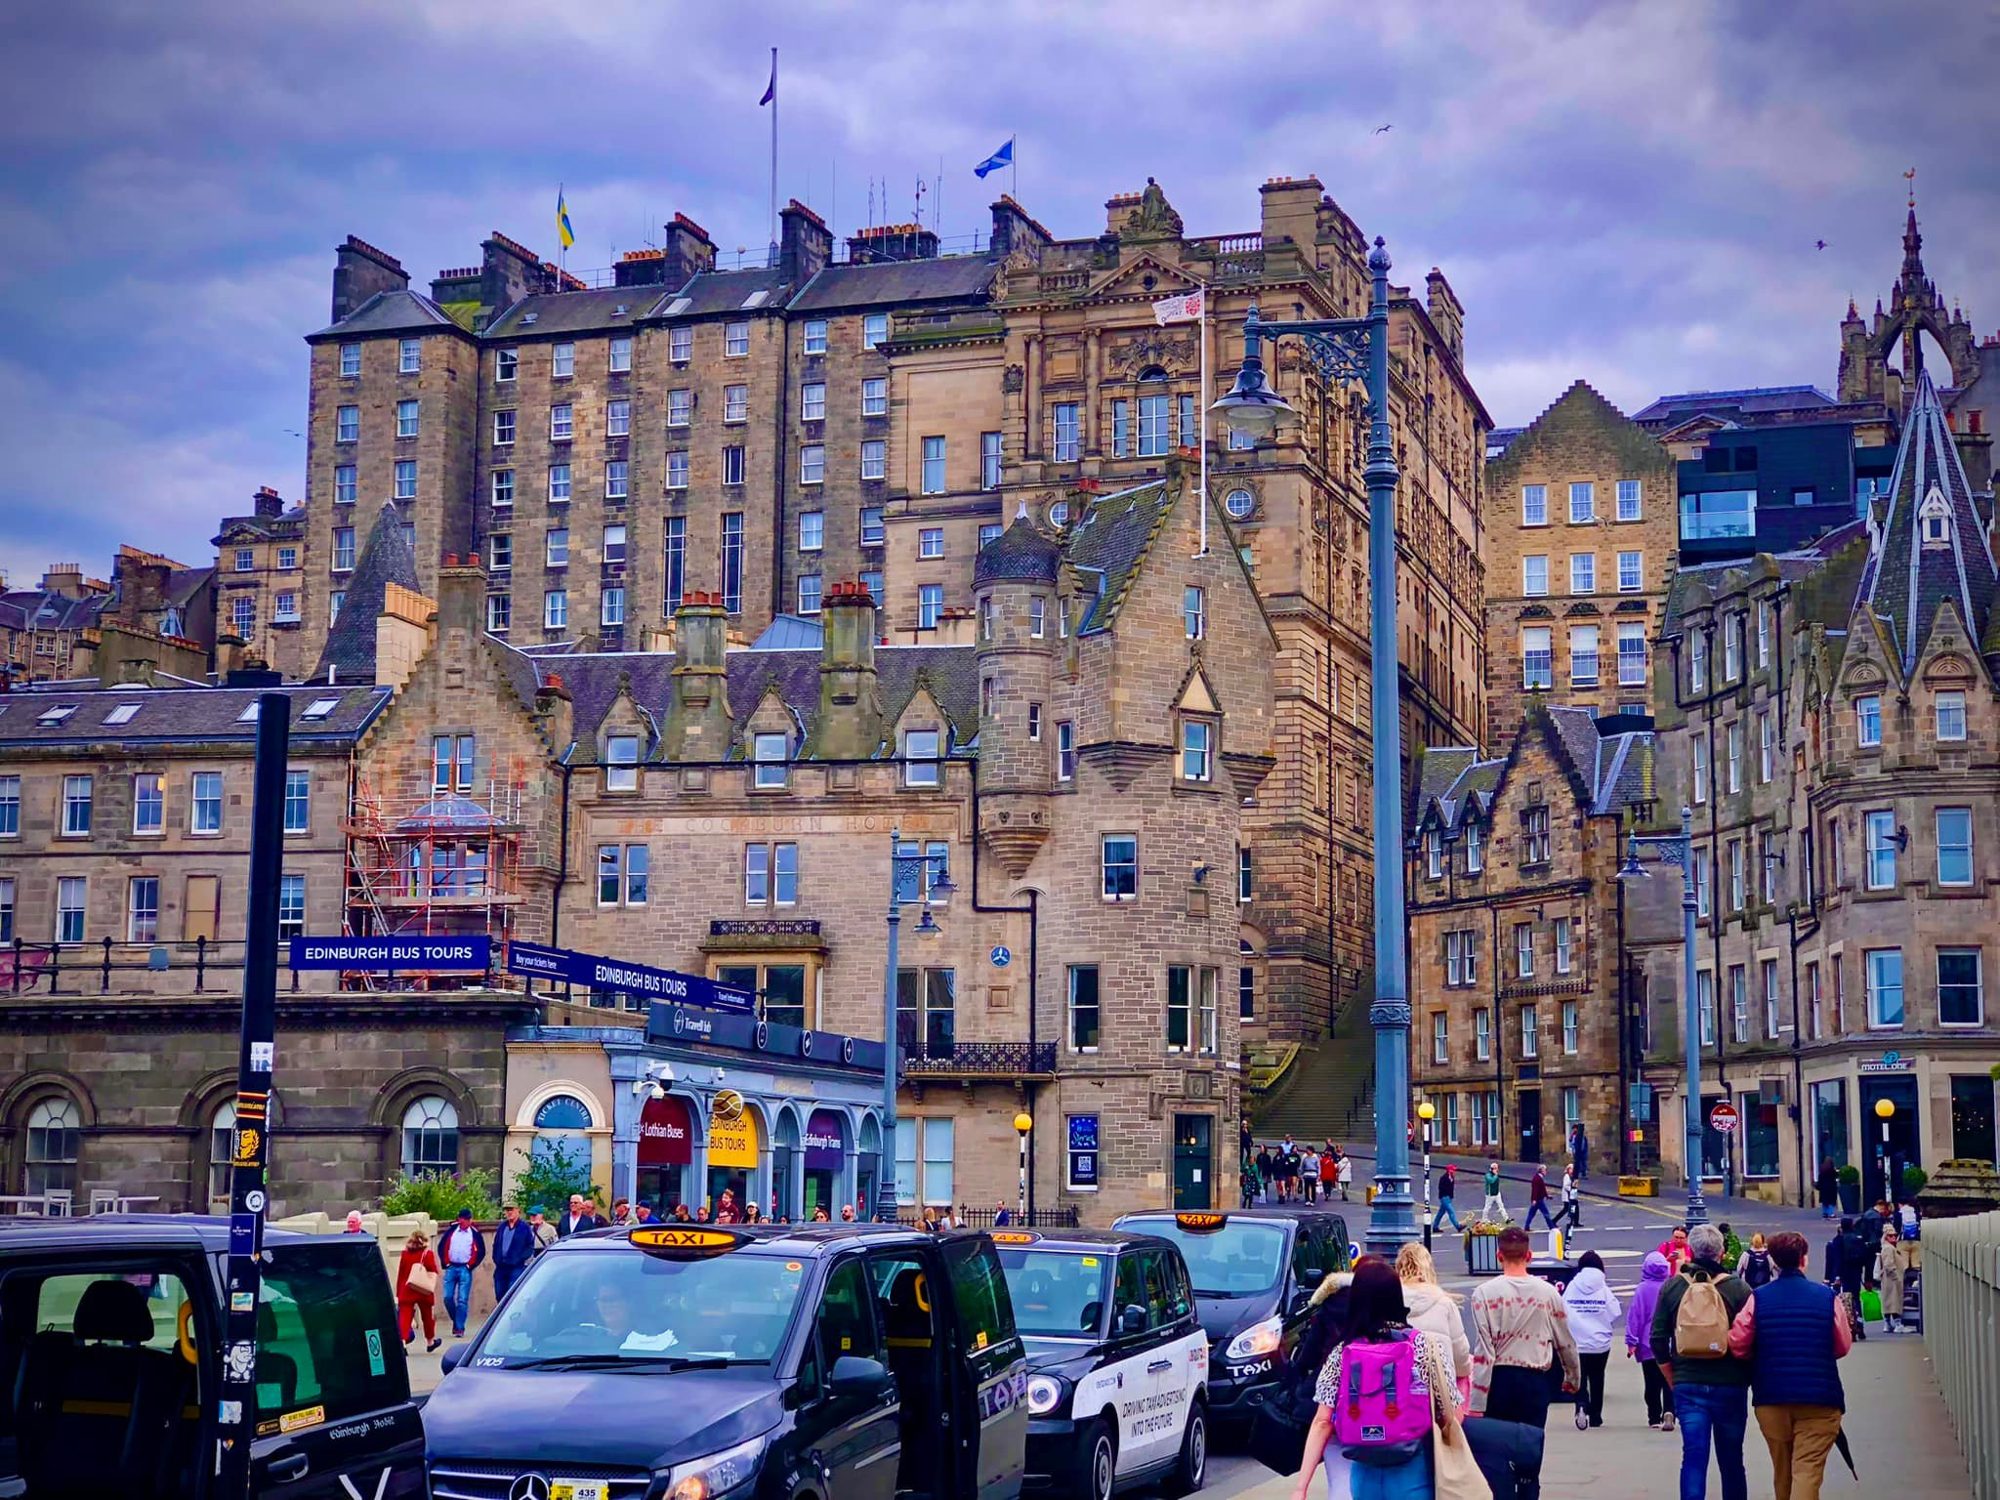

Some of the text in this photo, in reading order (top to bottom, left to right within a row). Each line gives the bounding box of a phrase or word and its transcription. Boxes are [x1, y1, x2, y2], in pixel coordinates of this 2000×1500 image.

[686, 817, 823, 832] COCKBURN
[846, 816, 930, 831] HOTEL
[304, 946, 473, 960] EDINBURGH BUS TOURS
[595, 965, 687, 997] EDINBURGH BUS TOURS
[1861, 1063, 1890, 1071] MOTEL
[537, 1098, 590, 1121] TICKET CENTRE
[644, 1122, 684, 1139] Lothian Buses
[710, 1117, 747, 1132] EDINBURGH
[710, 1136, 746, 1151] BUS TOURS
[805, 1133, 841, 1150] Edinburgh Trams
[1183, 1215, 1212, 1225] TAXI
[651, 1232, 705, 1245] TAXI
[476, 1357, 505, 1367] V105
[1225, 1359, 1273, 1378] TAXI
[1122, 1398, 1146, 1418] DRIVING
[329, 1422, 371, 1440] Edinburgh
[1131, 1412, 1173, 1438] INTO THE FUTURE
[578, 1488, 596, 1497] 435
